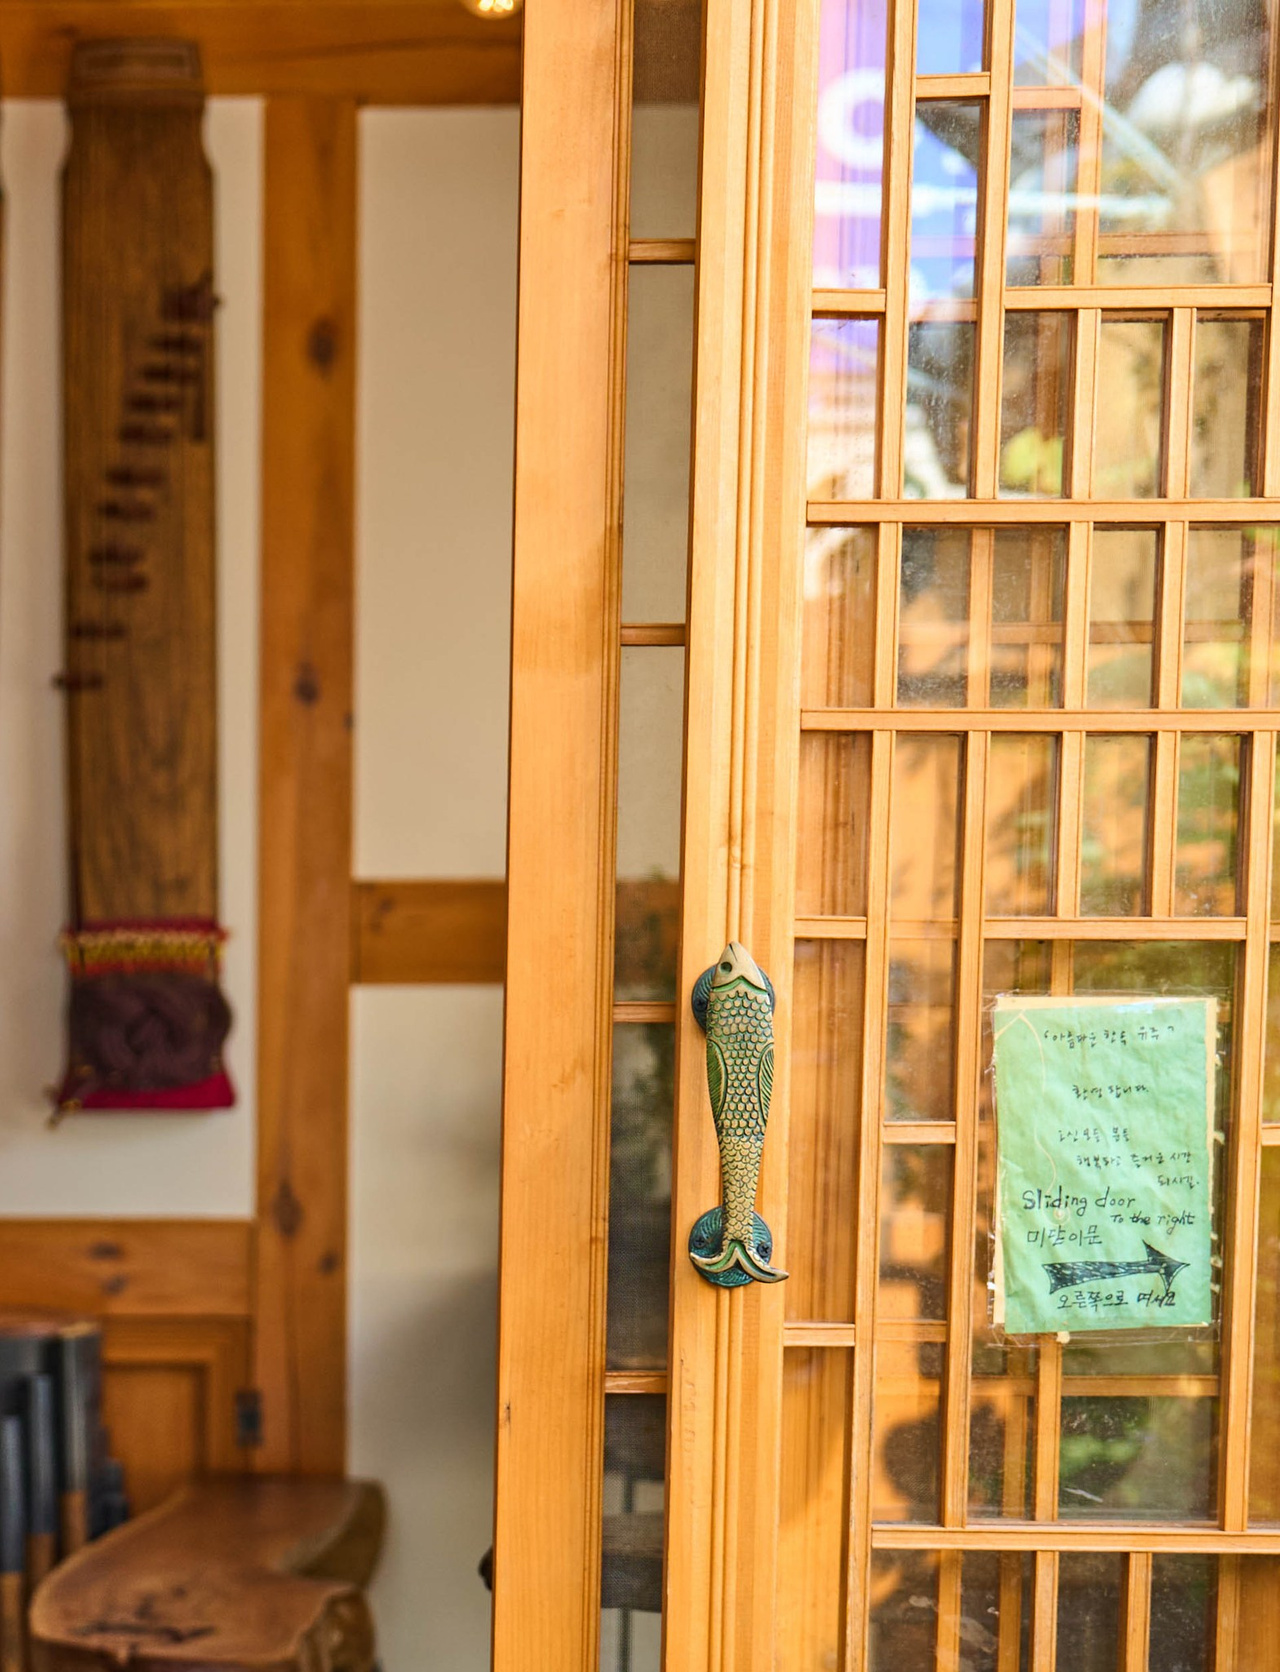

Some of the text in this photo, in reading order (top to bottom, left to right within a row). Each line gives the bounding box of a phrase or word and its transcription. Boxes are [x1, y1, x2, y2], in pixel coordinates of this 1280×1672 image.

[1112, 1127, 1130, 1143] 분들
[1077, 1151, 1192, 1170] 행복하고 즐거운 시간
[1022, 1185, 1136, 1217] Sliding door
[1129, 1210, 1151, 1226] the
[1157, 1210, 1196, 1236] right
[1027, 1224, 1103, 1248] 미닫이문
[1057, 1290, 1129, 1312] 오른쪽으로
